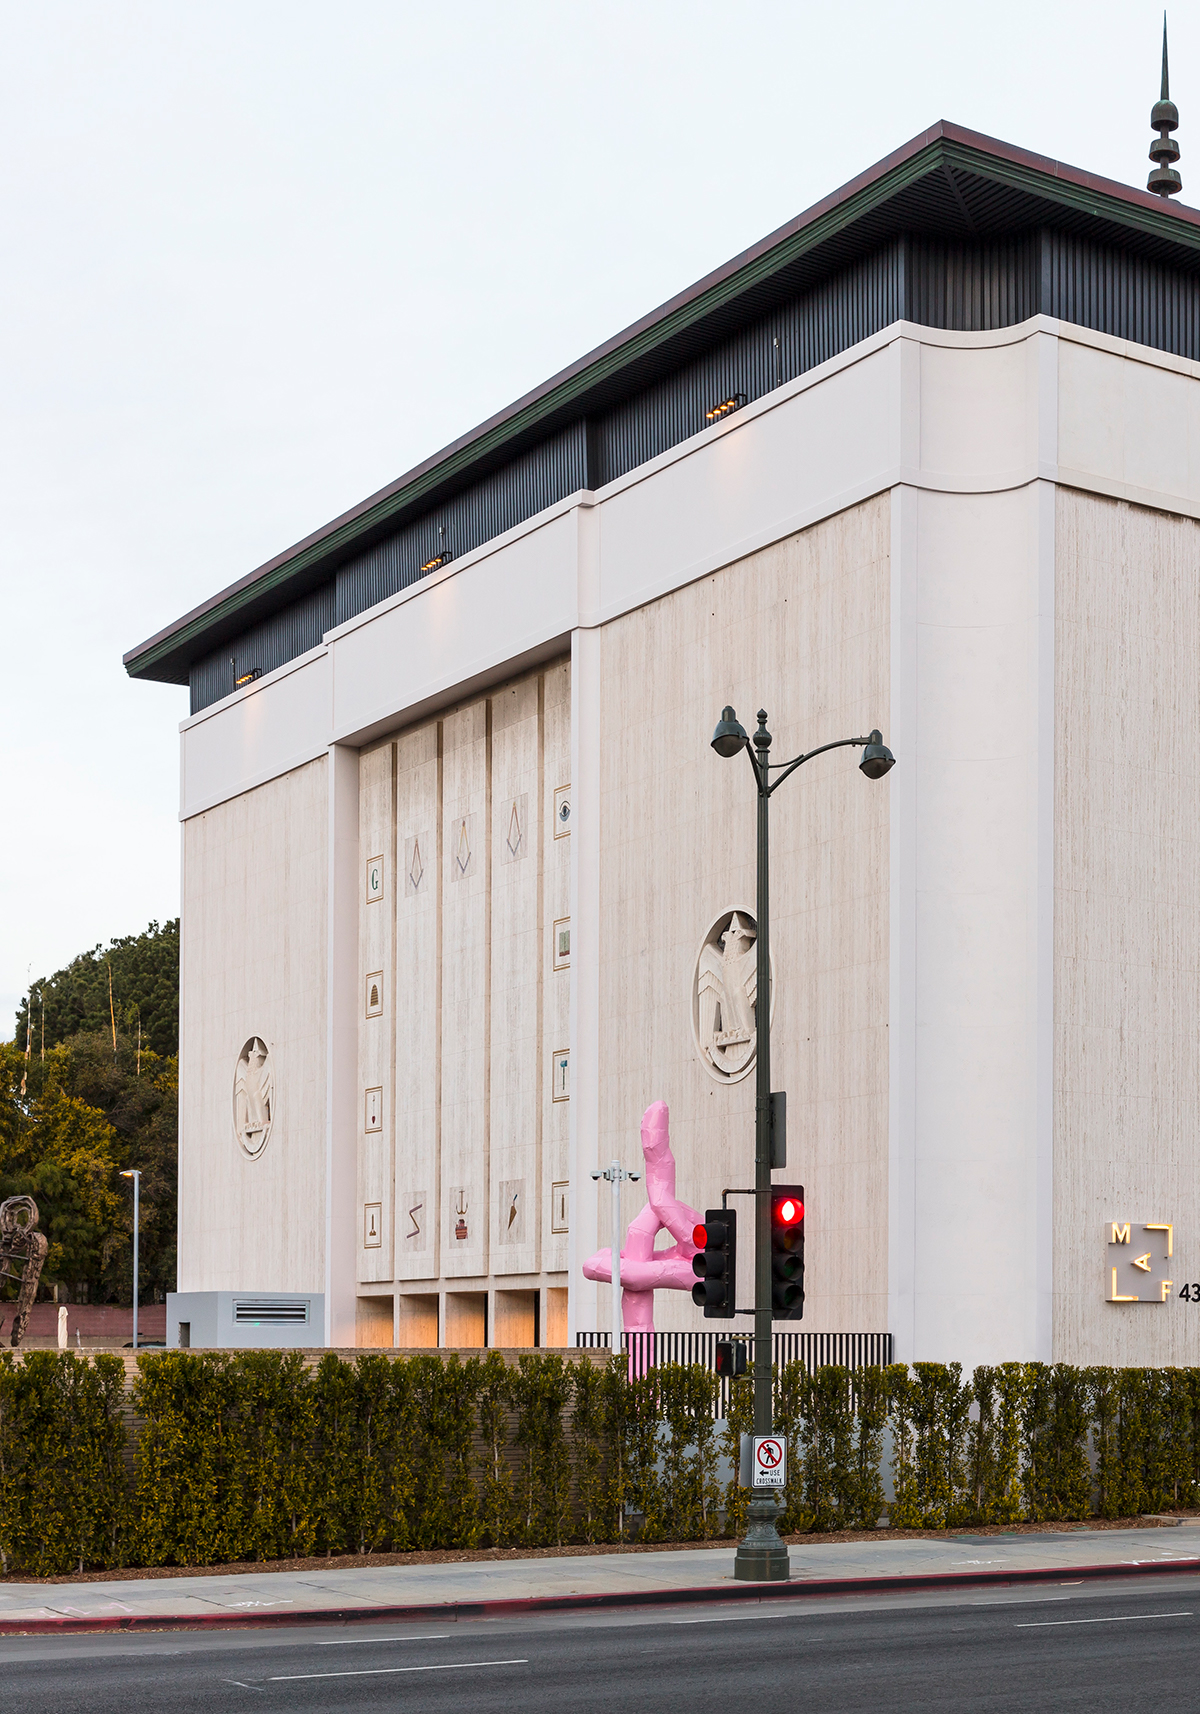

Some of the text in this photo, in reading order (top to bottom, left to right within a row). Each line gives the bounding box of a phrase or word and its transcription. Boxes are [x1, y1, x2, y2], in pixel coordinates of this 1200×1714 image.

[371, 868, 379, 890] G
[769, 1469, 781, 1477] USE
[756, 1477, 782, 1485] CROSSWALK
